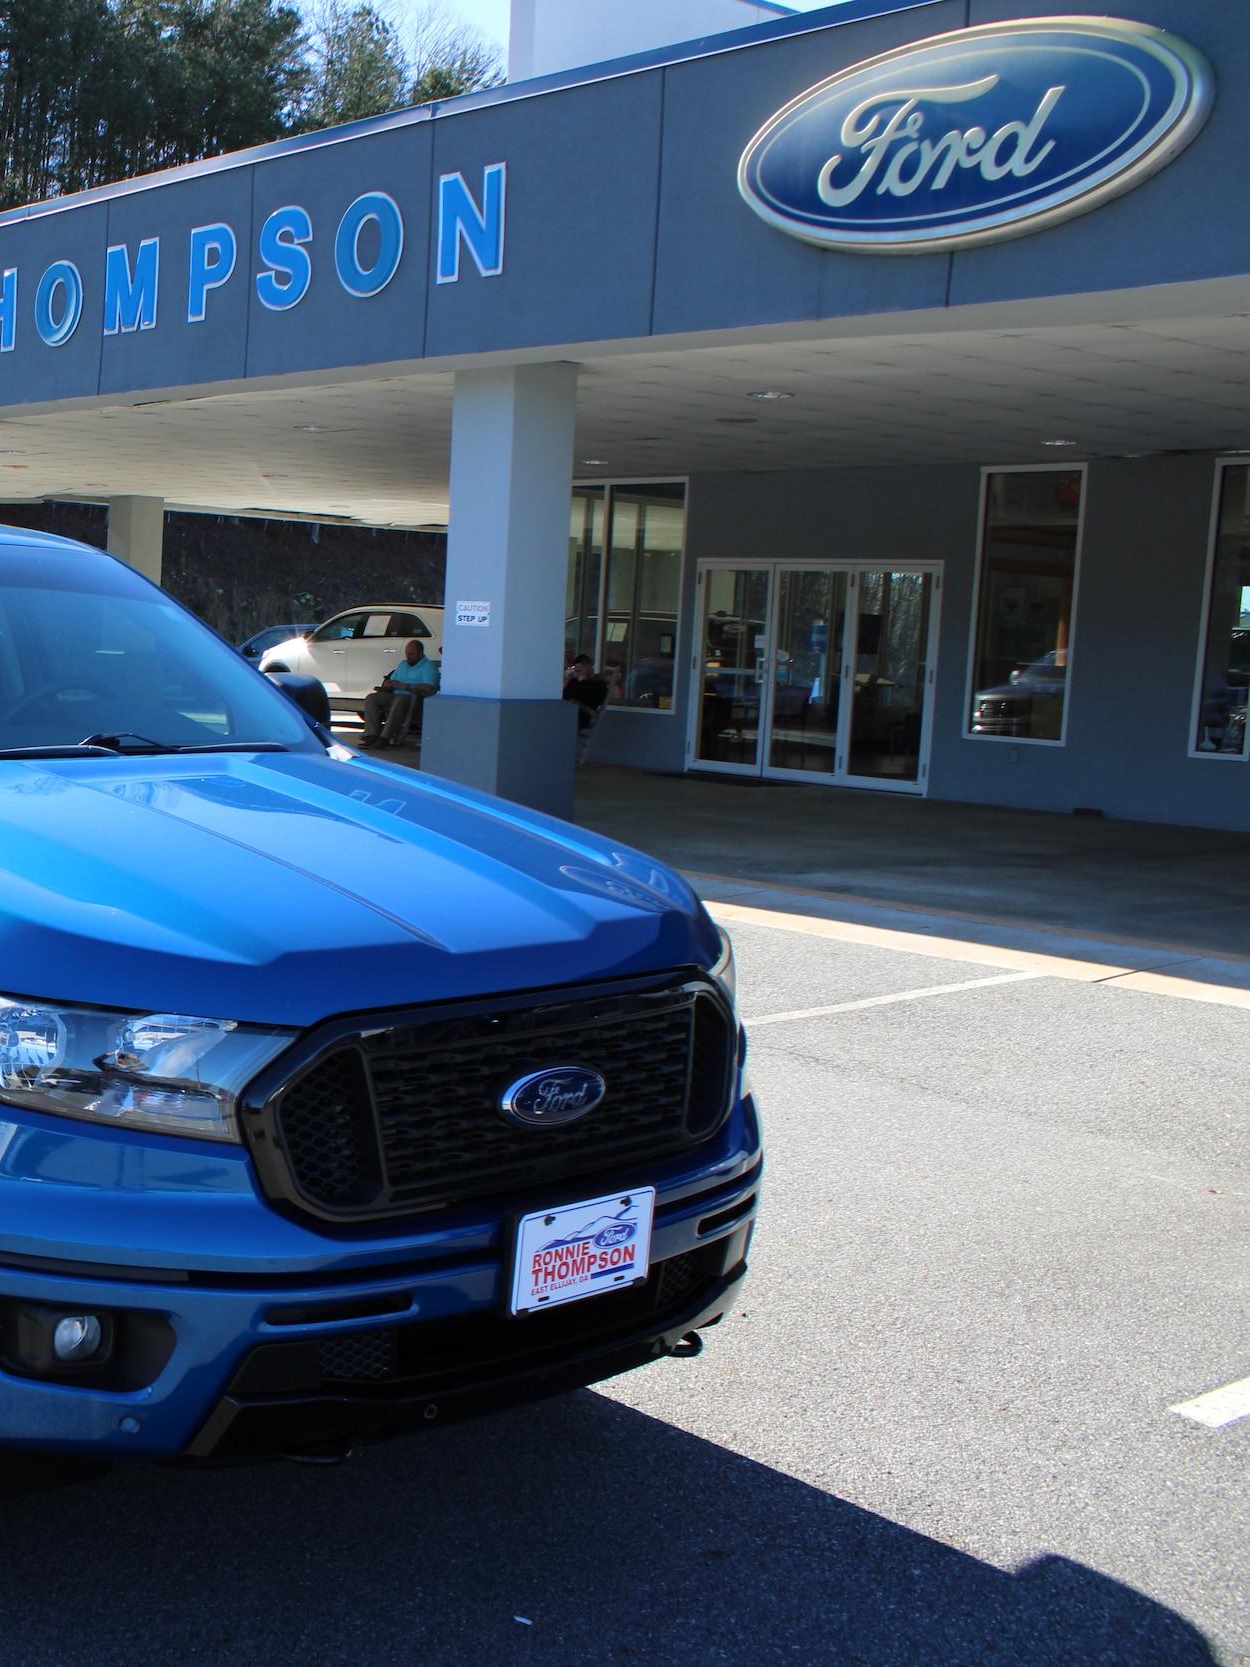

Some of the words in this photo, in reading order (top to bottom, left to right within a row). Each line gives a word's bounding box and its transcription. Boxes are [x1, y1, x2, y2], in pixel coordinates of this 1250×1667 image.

[817, 74, 1066, 207] Ford
[458, 604, 488, 612] CAUTION
[534, 1078, 588, 1115] Ford
[600, 1226, 630, 1246] Ford
[531, 1244, 636, 1287] THOMPSON
[532, 1241, 590, 1269] RONNIE
[531, 1286, 548, 1296] EAST
[550, 1279, 578, 1291] ELLIJAY,
[579, 1275, 589, 1283] GA
